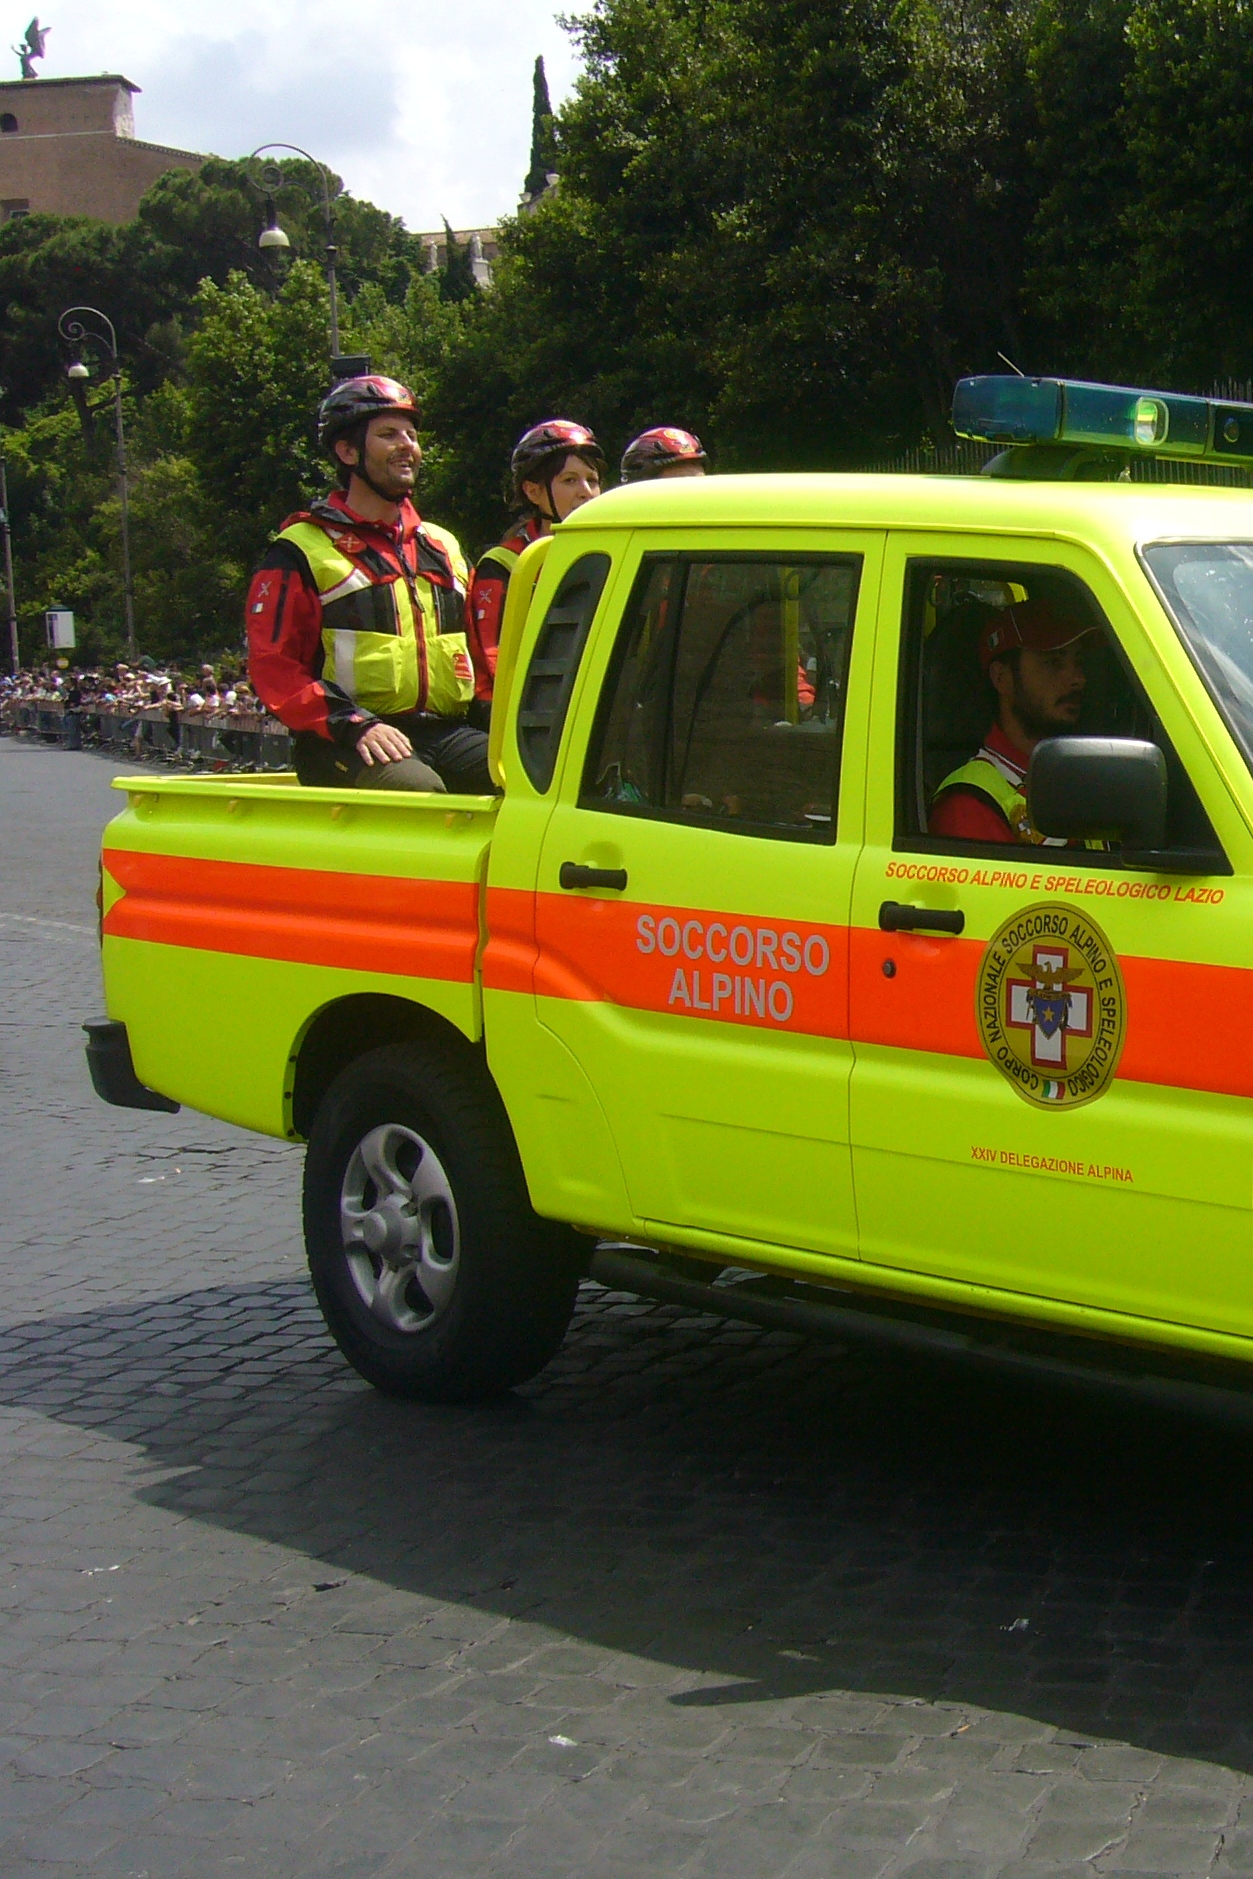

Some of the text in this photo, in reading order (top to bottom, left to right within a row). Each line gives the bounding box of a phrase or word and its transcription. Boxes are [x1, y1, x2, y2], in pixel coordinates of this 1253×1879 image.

[885, 862, 1225, 905] SOCCORSO ALPINO E SPELEOLOGICO LAZIO
[636, 915, 830, 976] SOCCORSO
[1002, 914, 1069, 954] SOCCORSO
[1070, 924, 1107, 973] ALPINO
[668, 968, 794, 1022] ALPINO
[983, 954, 1006, 1043] NAZIONALE
[1099, 977, 1113, 991] E
[996, 1046, 1039, 1090] CORPO
[1068, 996, 1116, 1097] SPELEOLOGICO
[971, 1146, 1134, 1183] XXIV DELEGAZIONE ALPINA
